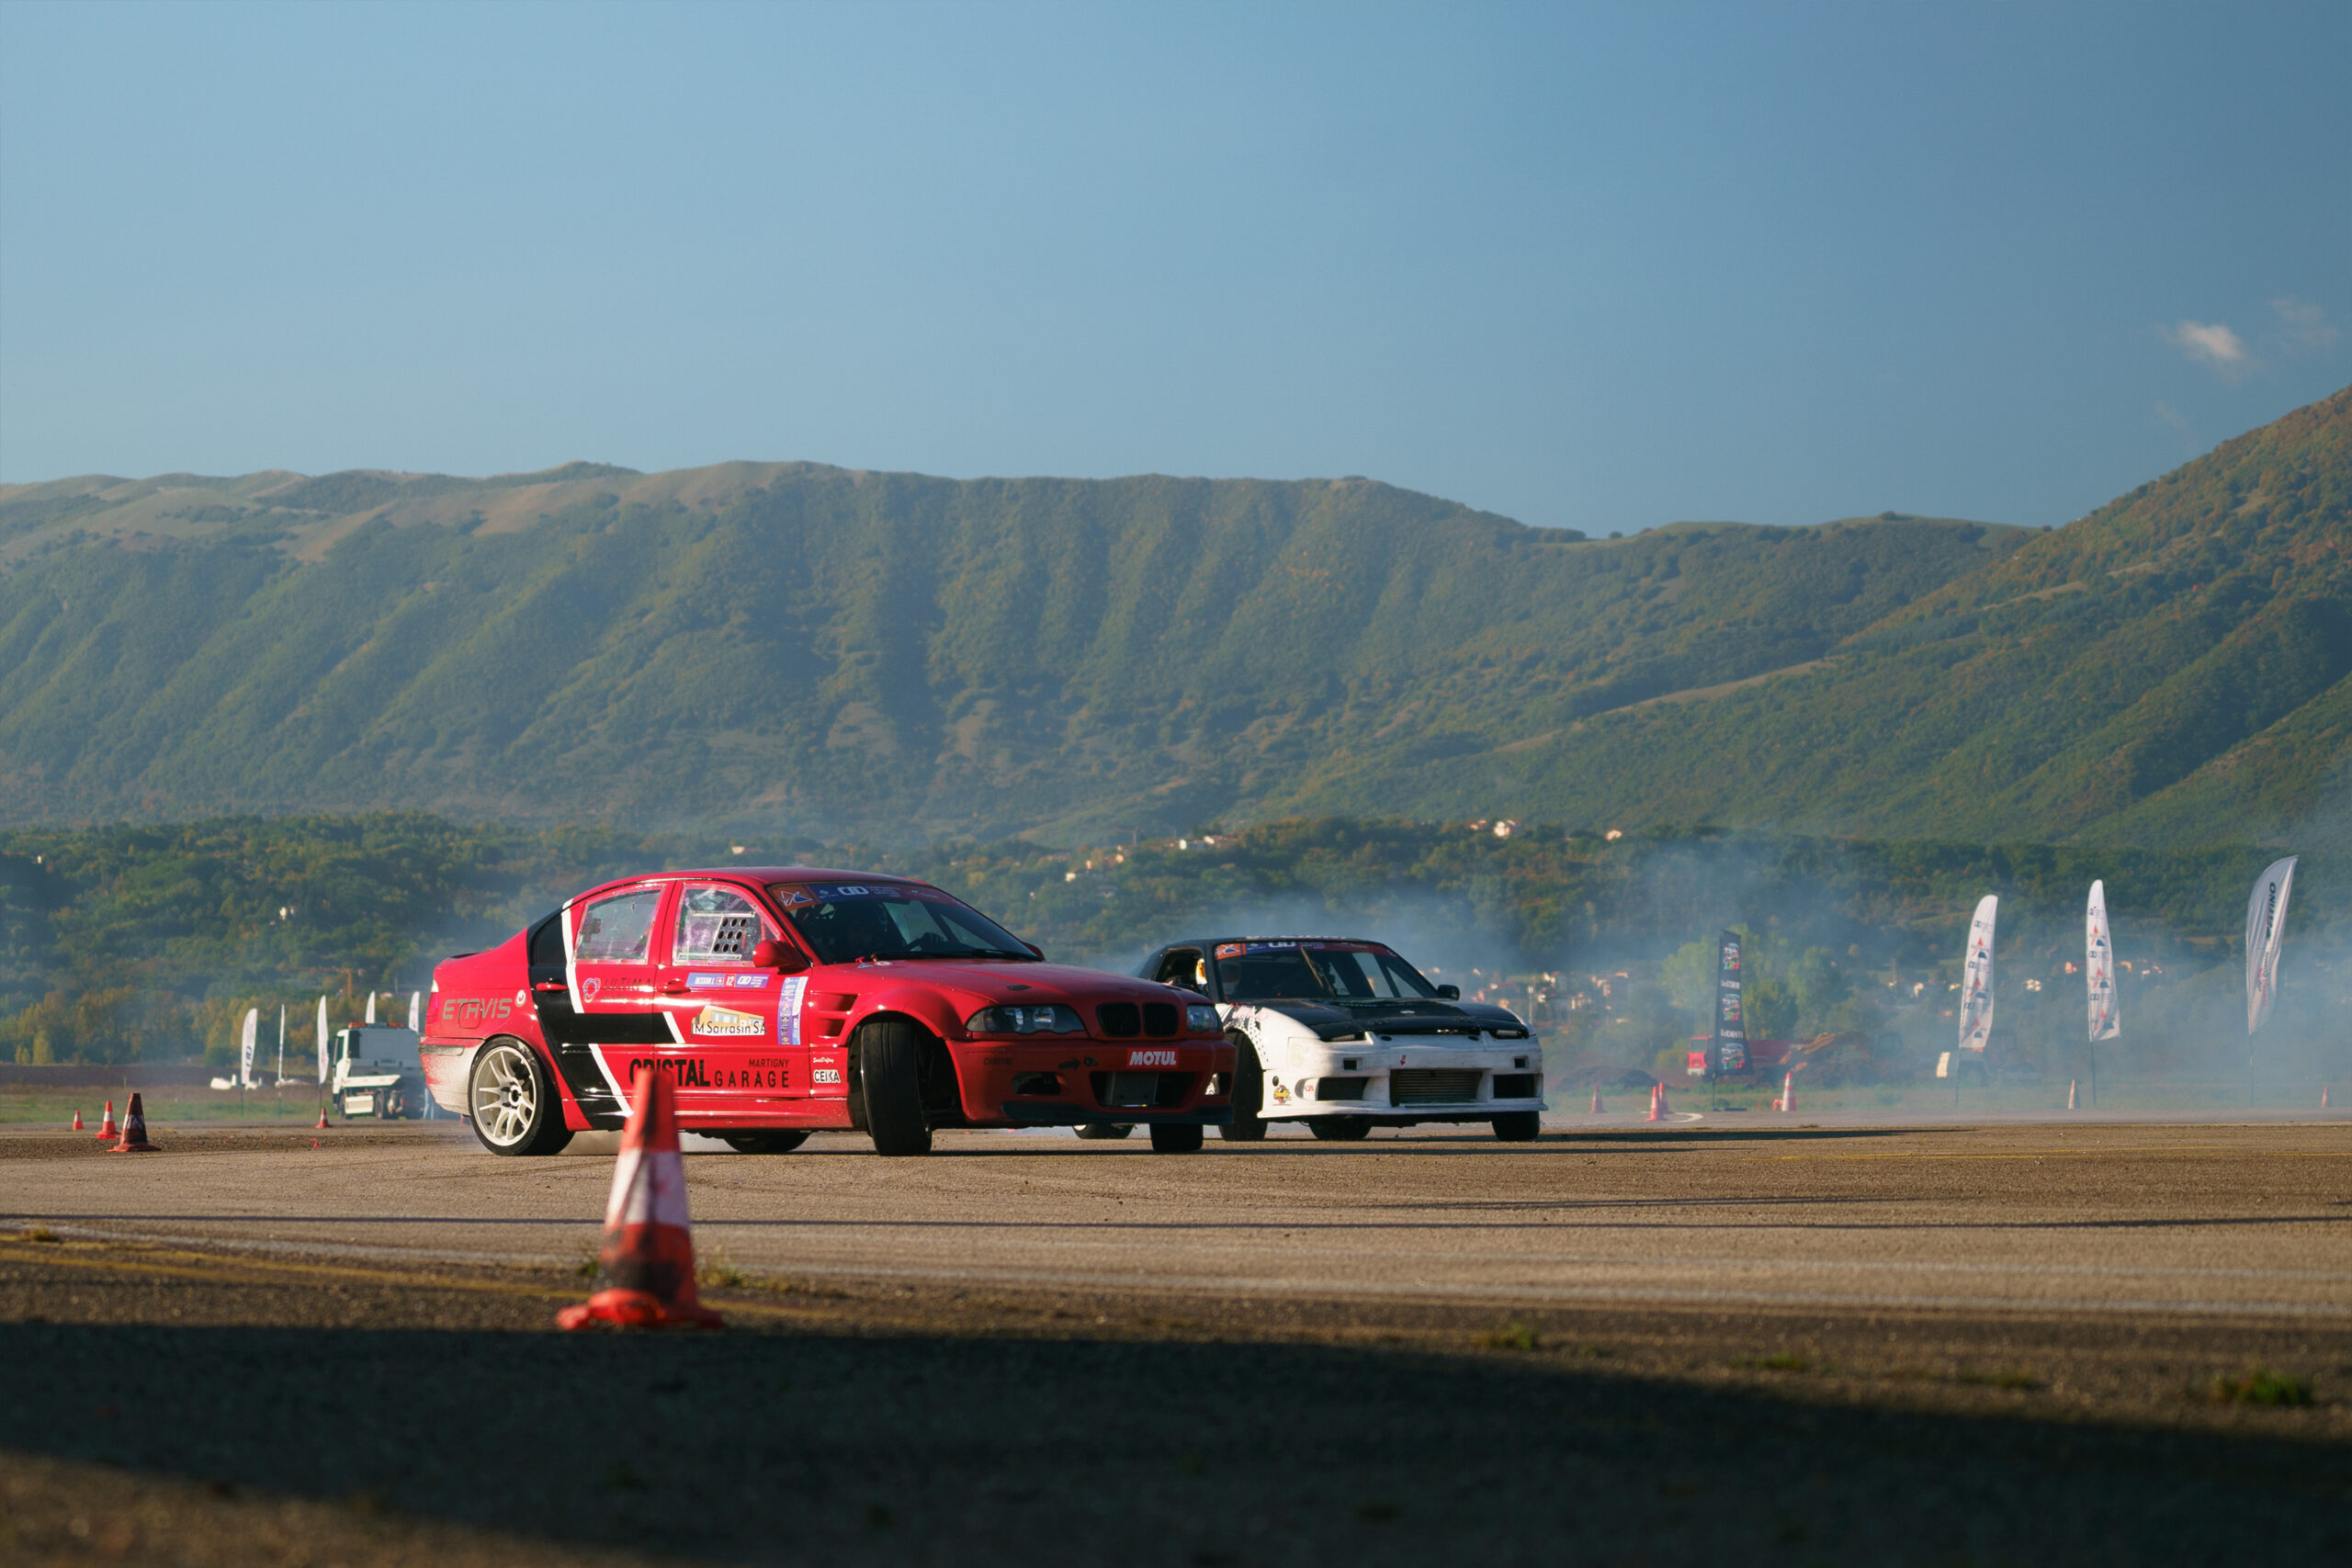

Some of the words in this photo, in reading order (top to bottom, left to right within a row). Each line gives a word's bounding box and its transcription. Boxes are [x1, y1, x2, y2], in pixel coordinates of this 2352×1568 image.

[726, 976, 734, 986] 12
[442, 998, 513, 1020] ETAVIS
[707, 1021, 751, 1034] Sarrasin
[753, 1021, 767, 1034] SA
[748, 1058, 790, 1068] MARTIGNY
[1128, 1051, 1177, 1066] MOTUL
[715, 1070, 790, 1089] GARAGE
